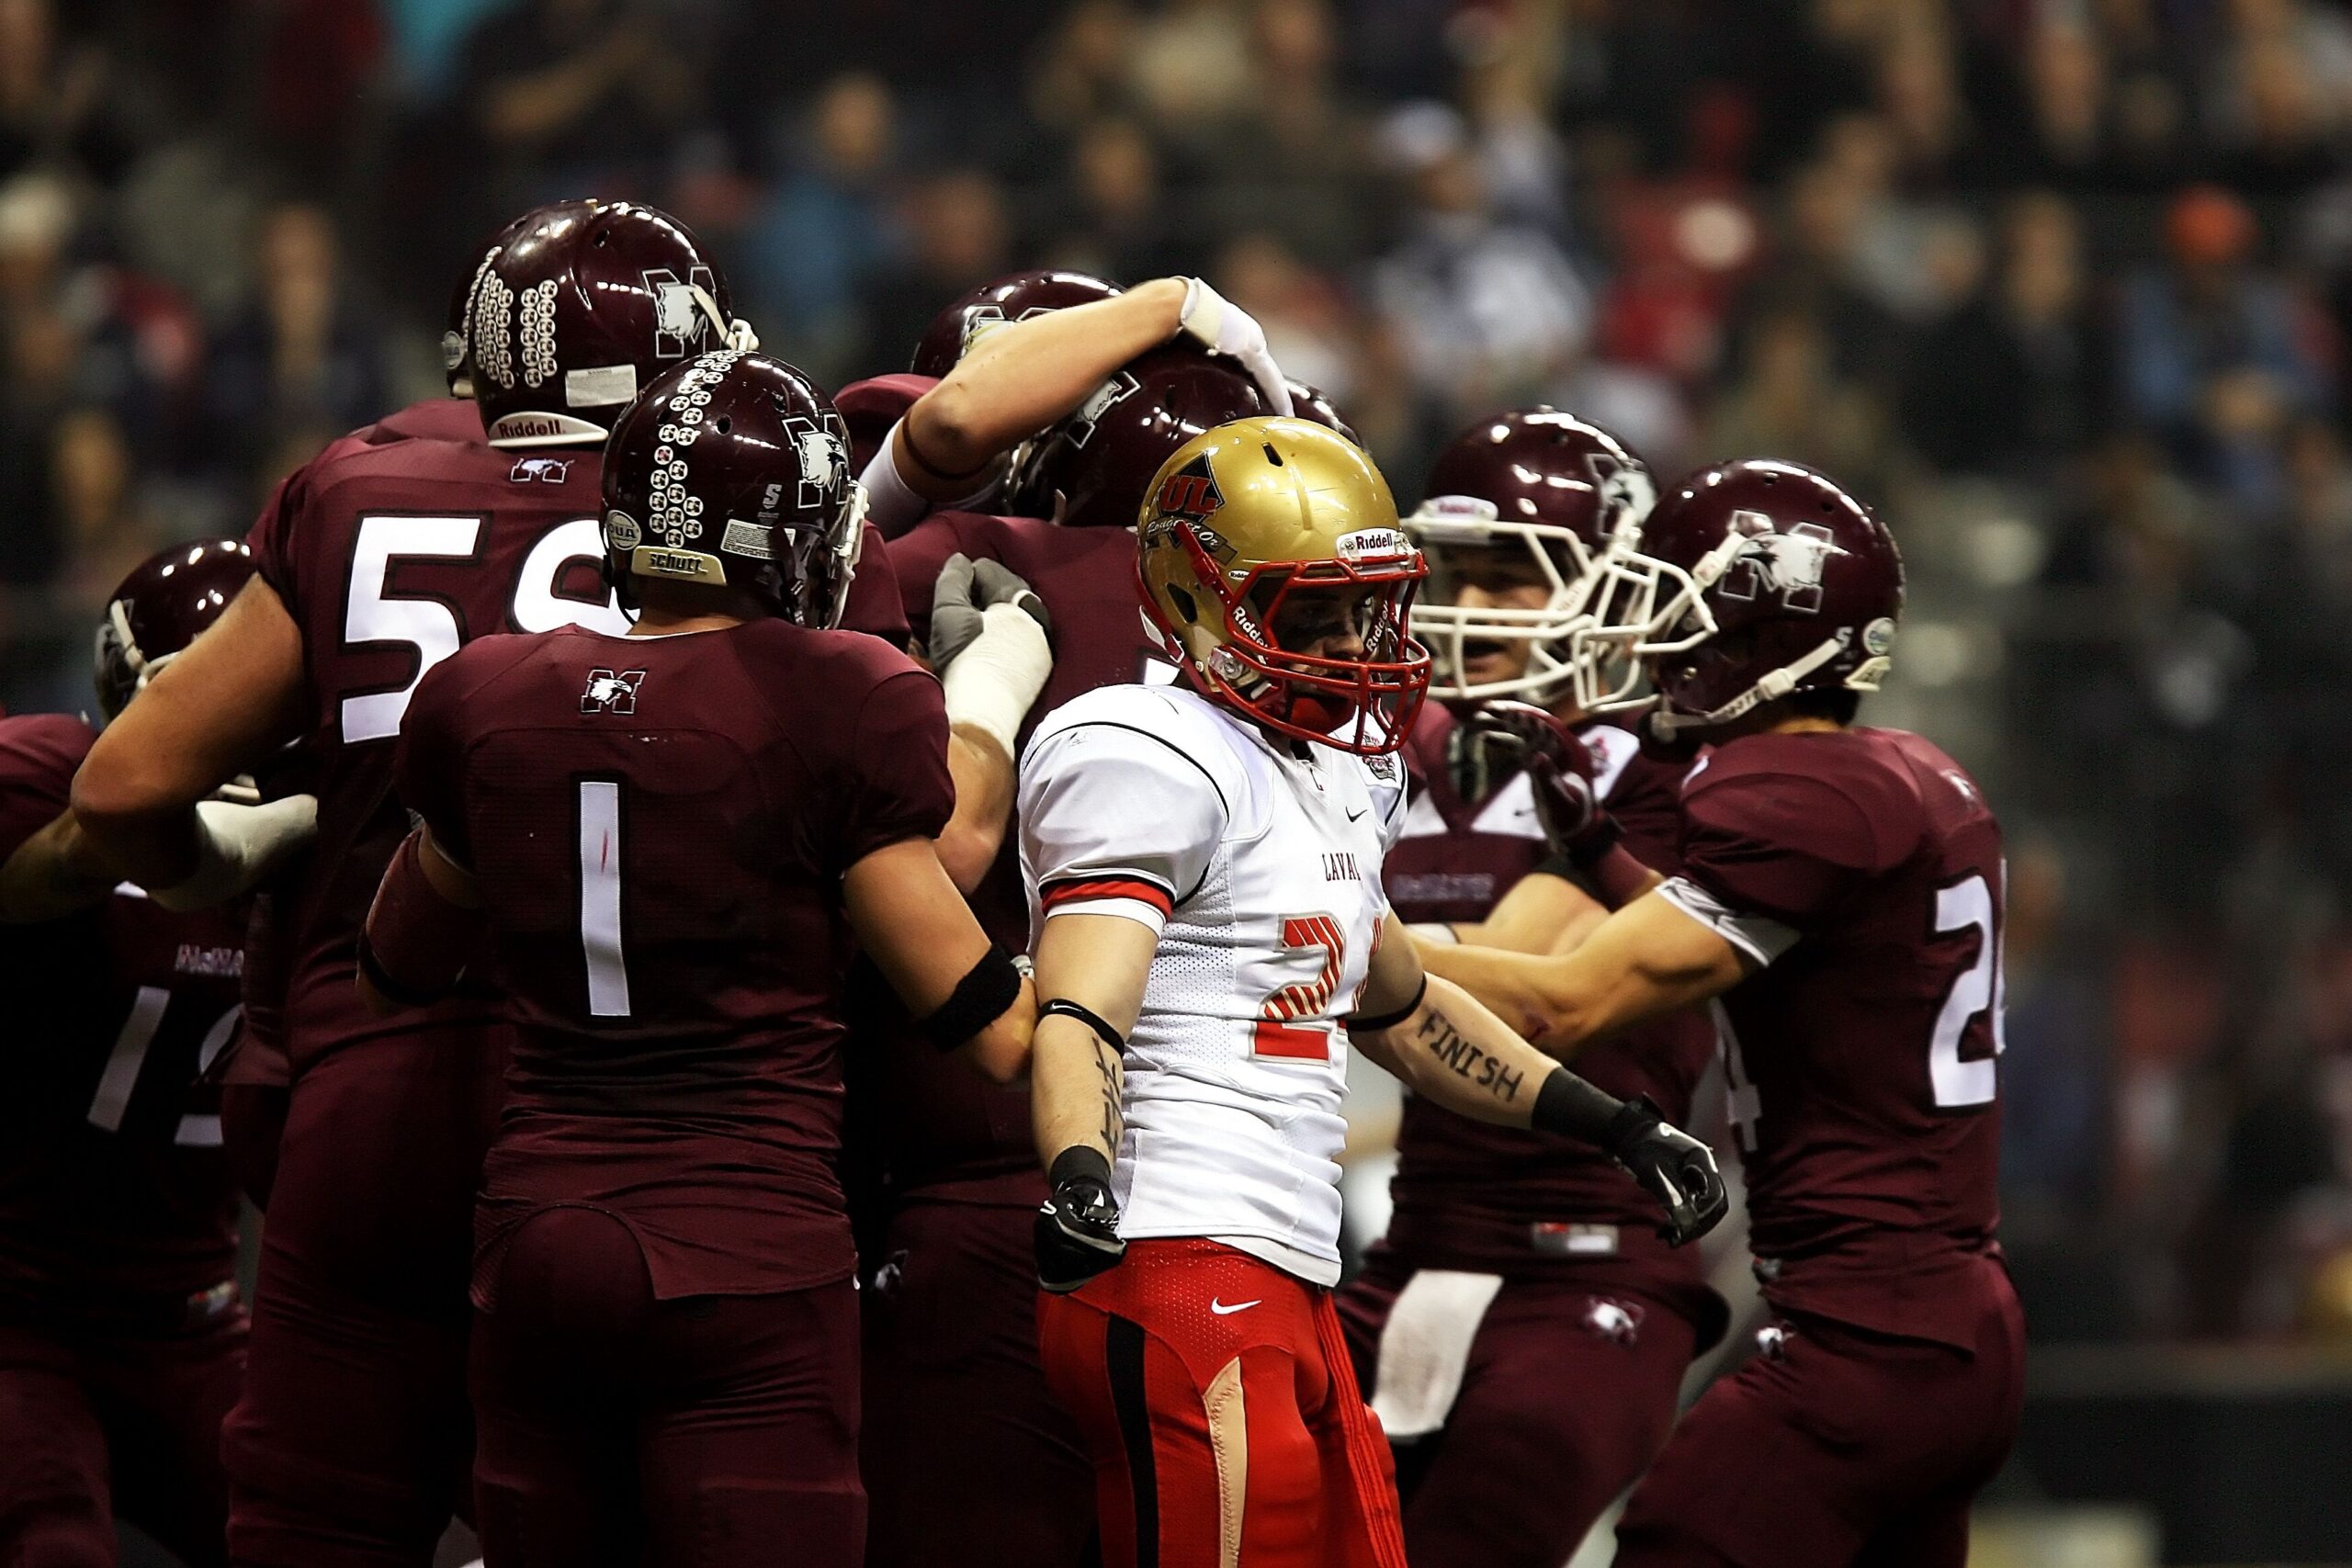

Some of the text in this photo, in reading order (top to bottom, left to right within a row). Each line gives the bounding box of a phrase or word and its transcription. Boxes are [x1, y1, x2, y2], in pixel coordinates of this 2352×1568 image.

[497, 419, 562, 438] Riddell
[1159, 474, 1217, 515] UL
[1355, 533, 1394, 550] Riddell
[1233, 605, 1269, 649] Ridde
[580, 782, 631, 1017] 1
[1248, 909, 1383, 1068] 2
[1929, 859, 2007, 1107] 2
[1418, 1010, 1525, 1102] FINISH
